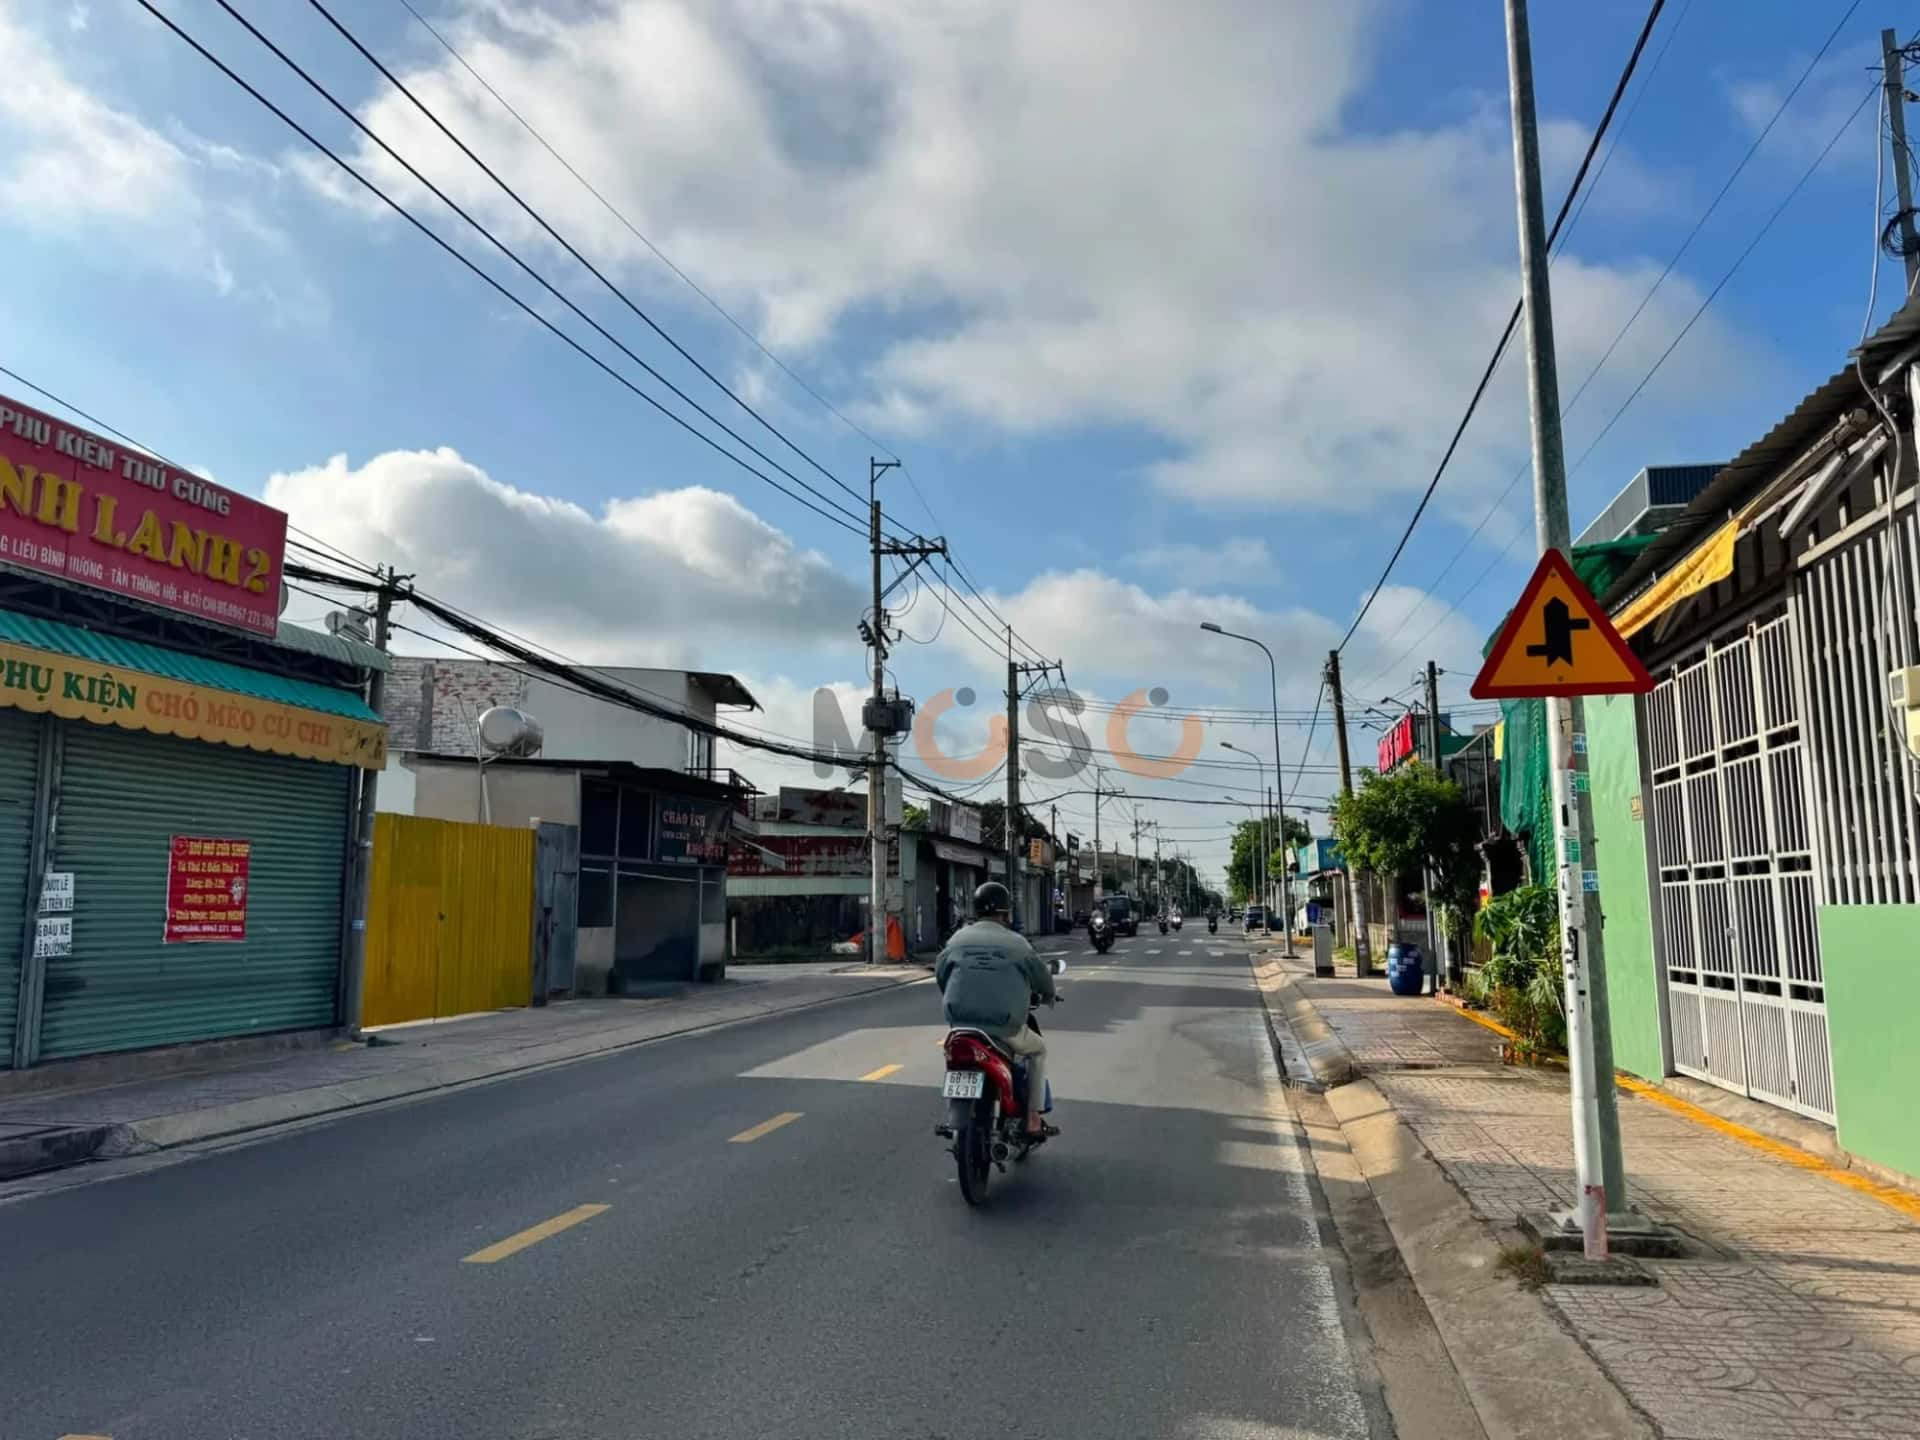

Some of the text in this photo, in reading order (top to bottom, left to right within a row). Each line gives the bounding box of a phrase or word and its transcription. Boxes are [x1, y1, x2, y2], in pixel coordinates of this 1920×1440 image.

[56, 429, 114, 472] KIỆN
[121, 455, 168, 491] THÚ
[63, 671, 137, 712] KIỆN
[146, 690, 199, 720] CHÓ
[297, 721, 331, 746] CHI
